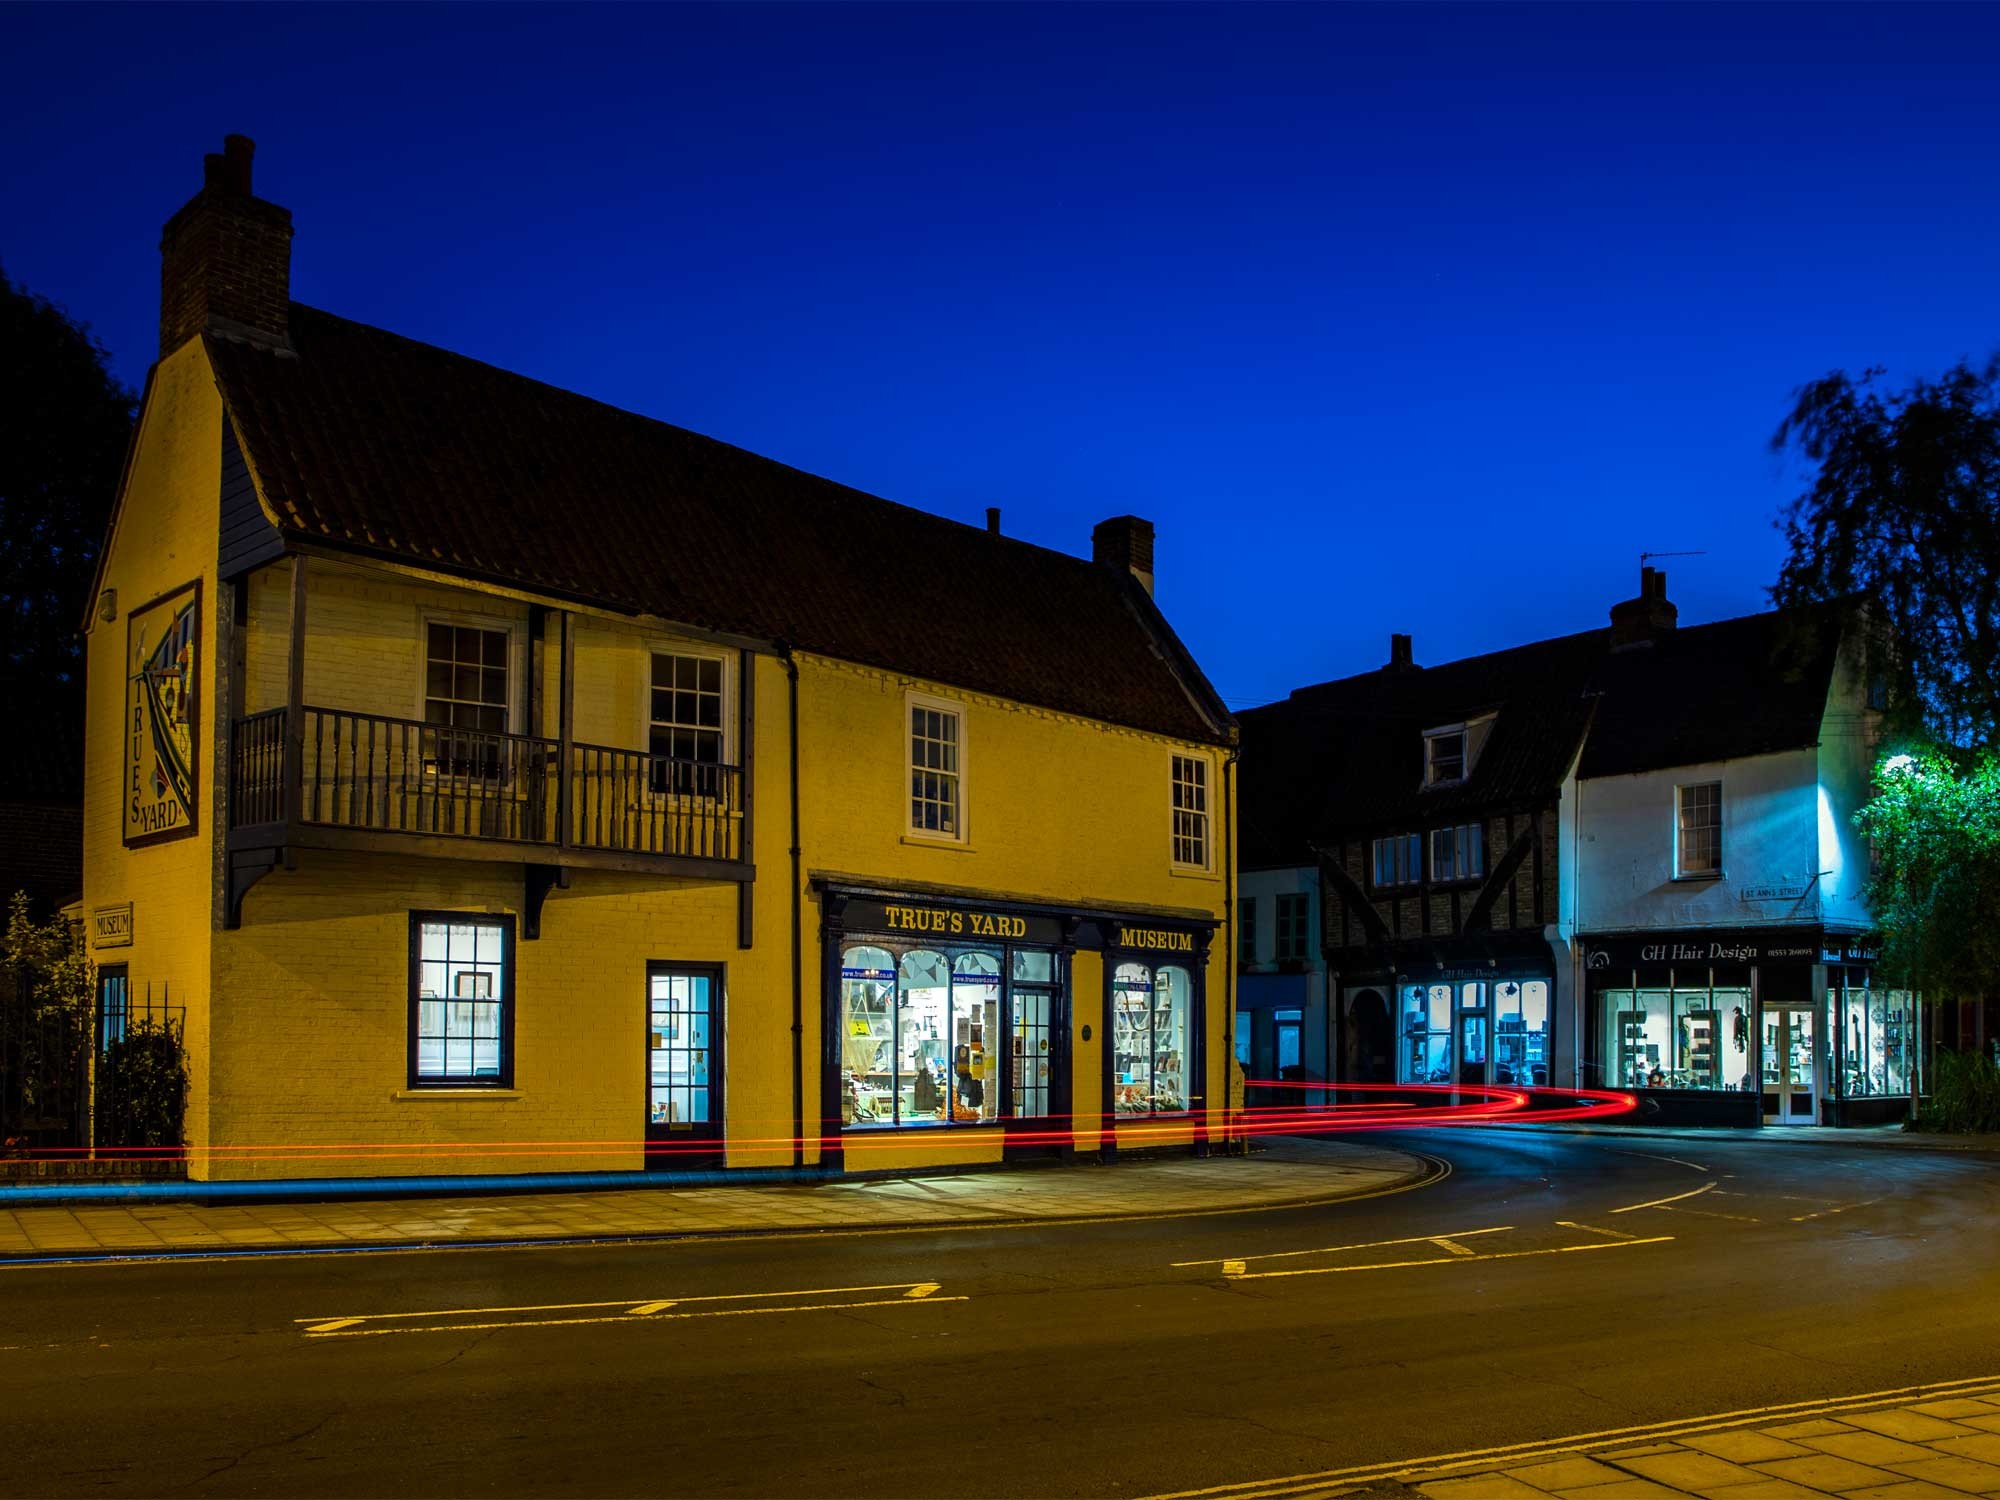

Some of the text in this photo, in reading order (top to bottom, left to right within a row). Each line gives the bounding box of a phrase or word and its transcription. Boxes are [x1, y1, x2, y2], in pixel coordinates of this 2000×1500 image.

[141, 800, 177, 832] YARD
[1779, 886, 1803, 896] STREET
[97, 913, 129, 936] MUSEUM
[884, 905, 1026, 938] TRUE'S YARD
[1120, 927, 1193, 951] MUSEUM
[1641, 944, 1667, 961] GH
[1671, 943, 1705, 961] Hair
[1708, 942, 1758, 962] Design
